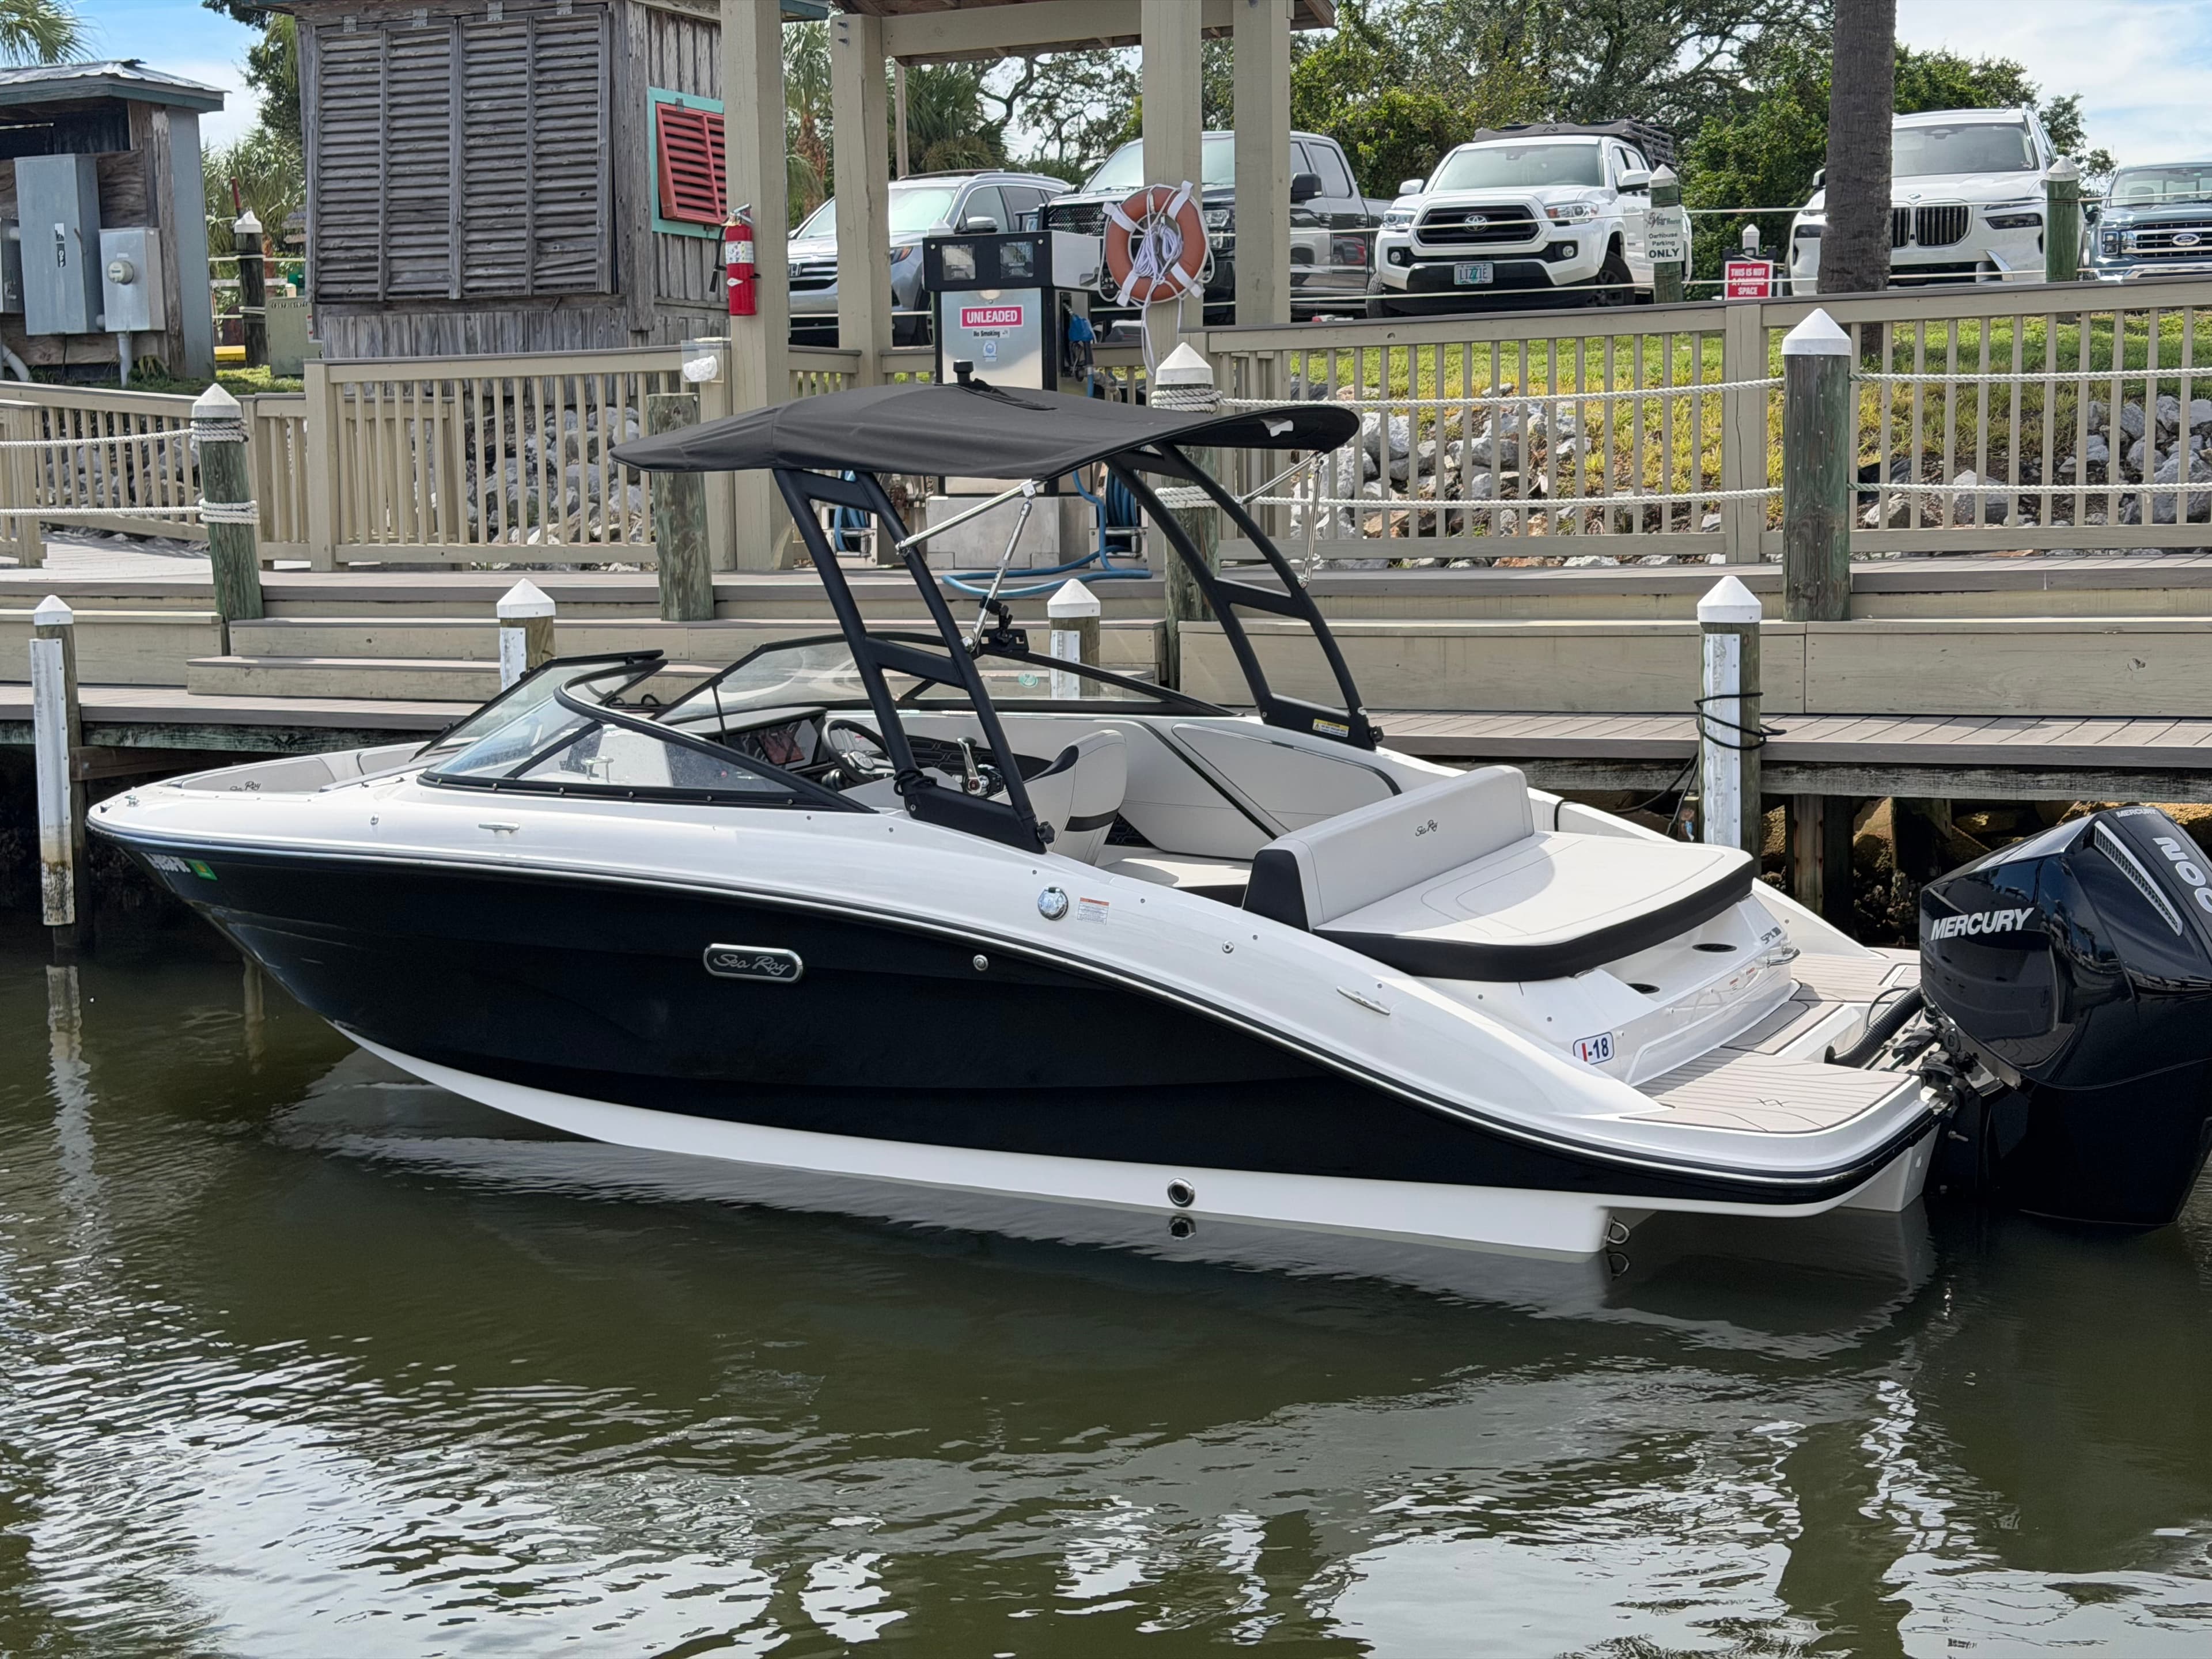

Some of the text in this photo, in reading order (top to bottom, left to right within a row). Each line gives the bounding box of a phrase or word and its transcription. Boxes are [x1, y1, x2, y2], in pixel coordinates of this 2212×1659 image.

[1649, 248, 1680, 258] ONLY
[1460, 268, 1488, 280] LIZZIE
[1731, 267, 1766, 276] THIS IS NOT
[1738, 287, 1758, 295] SPACE
[967, 310, 1018, 324] UNLEADED
[2115, 808, 2157, 818] MERCURY
[1930, 907, 2035, 941] MERCURY
[713, 954, 790, 976] Sea Ray
[1582, 1037, 1609, 1062] I-18
